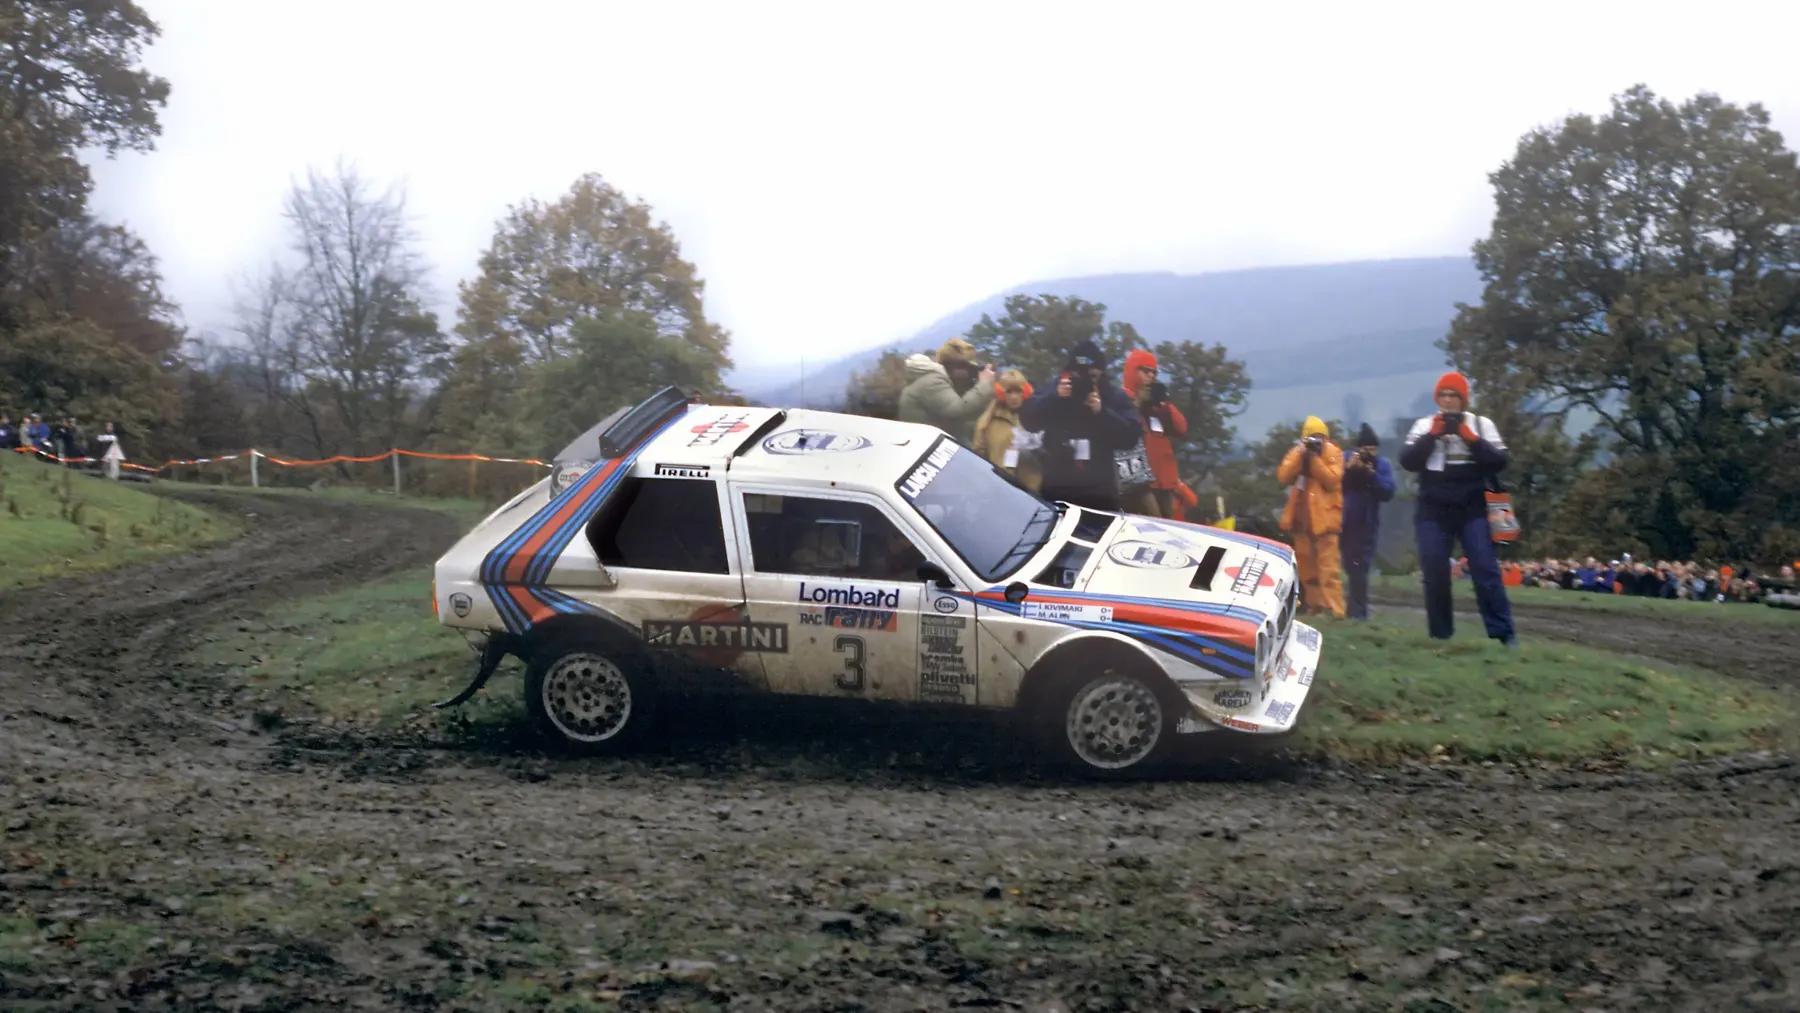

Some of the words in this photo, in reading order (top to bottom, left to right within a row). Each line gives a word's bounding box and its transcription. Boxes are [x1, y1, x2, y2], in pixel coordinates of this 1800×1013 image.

[654, 463, 710, 478] PIRELLI
[899, 461, 940, 499] LANCIA
[799, 582, 900, 608] Lombard
[799, 612, 823, 626] RAC
[647, 623, 784, 649] MARTINI
[833, 633, 867, 692] 3
[1222, 717, 1259, 732] WEBER
